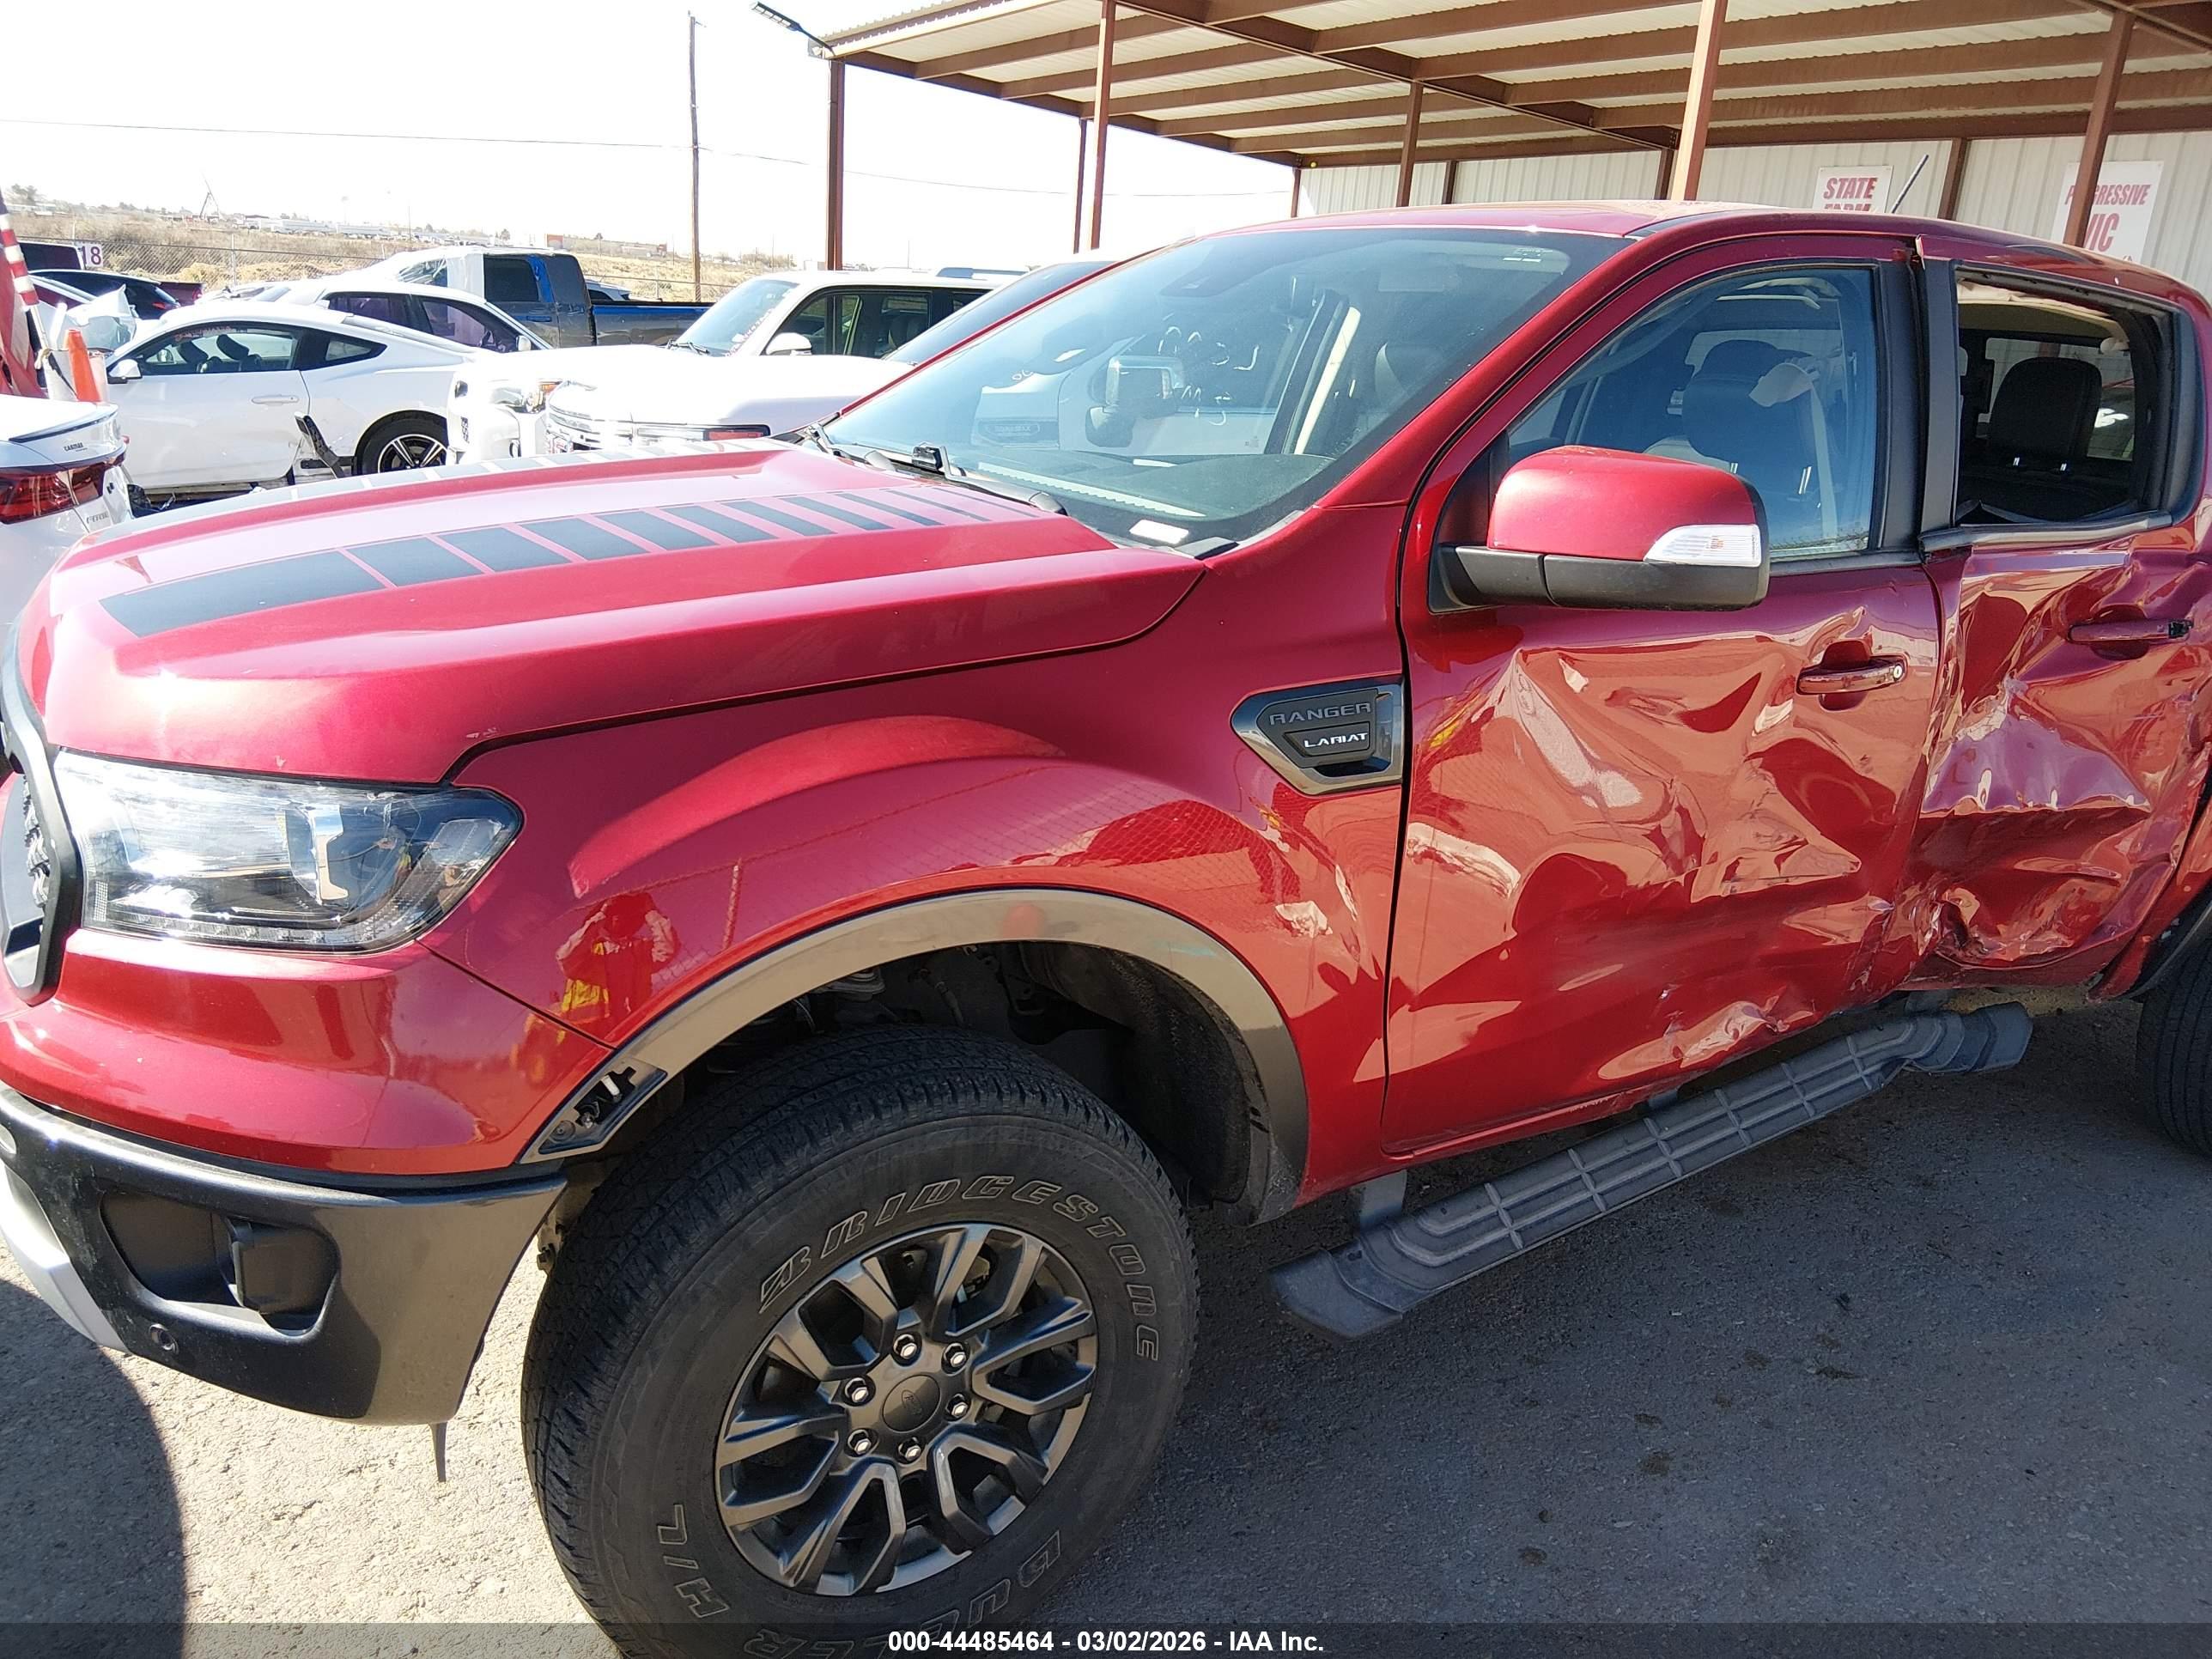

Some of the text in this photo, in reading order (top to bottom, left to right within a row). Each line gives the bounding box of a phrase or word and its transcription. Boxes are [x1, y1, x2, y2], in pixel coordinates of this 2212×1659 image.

[1823, 177, 1878, 199] STATE
[2064, 184, 2151, 205] PGRESSIVE
[82, 246, 102, 265] 18
[1269, 702, 1371, 726] RANGER
[1304, 732, 1368, 748] LARIAT
[759, 1176, 1158, 1361] BRIDGESTONE
